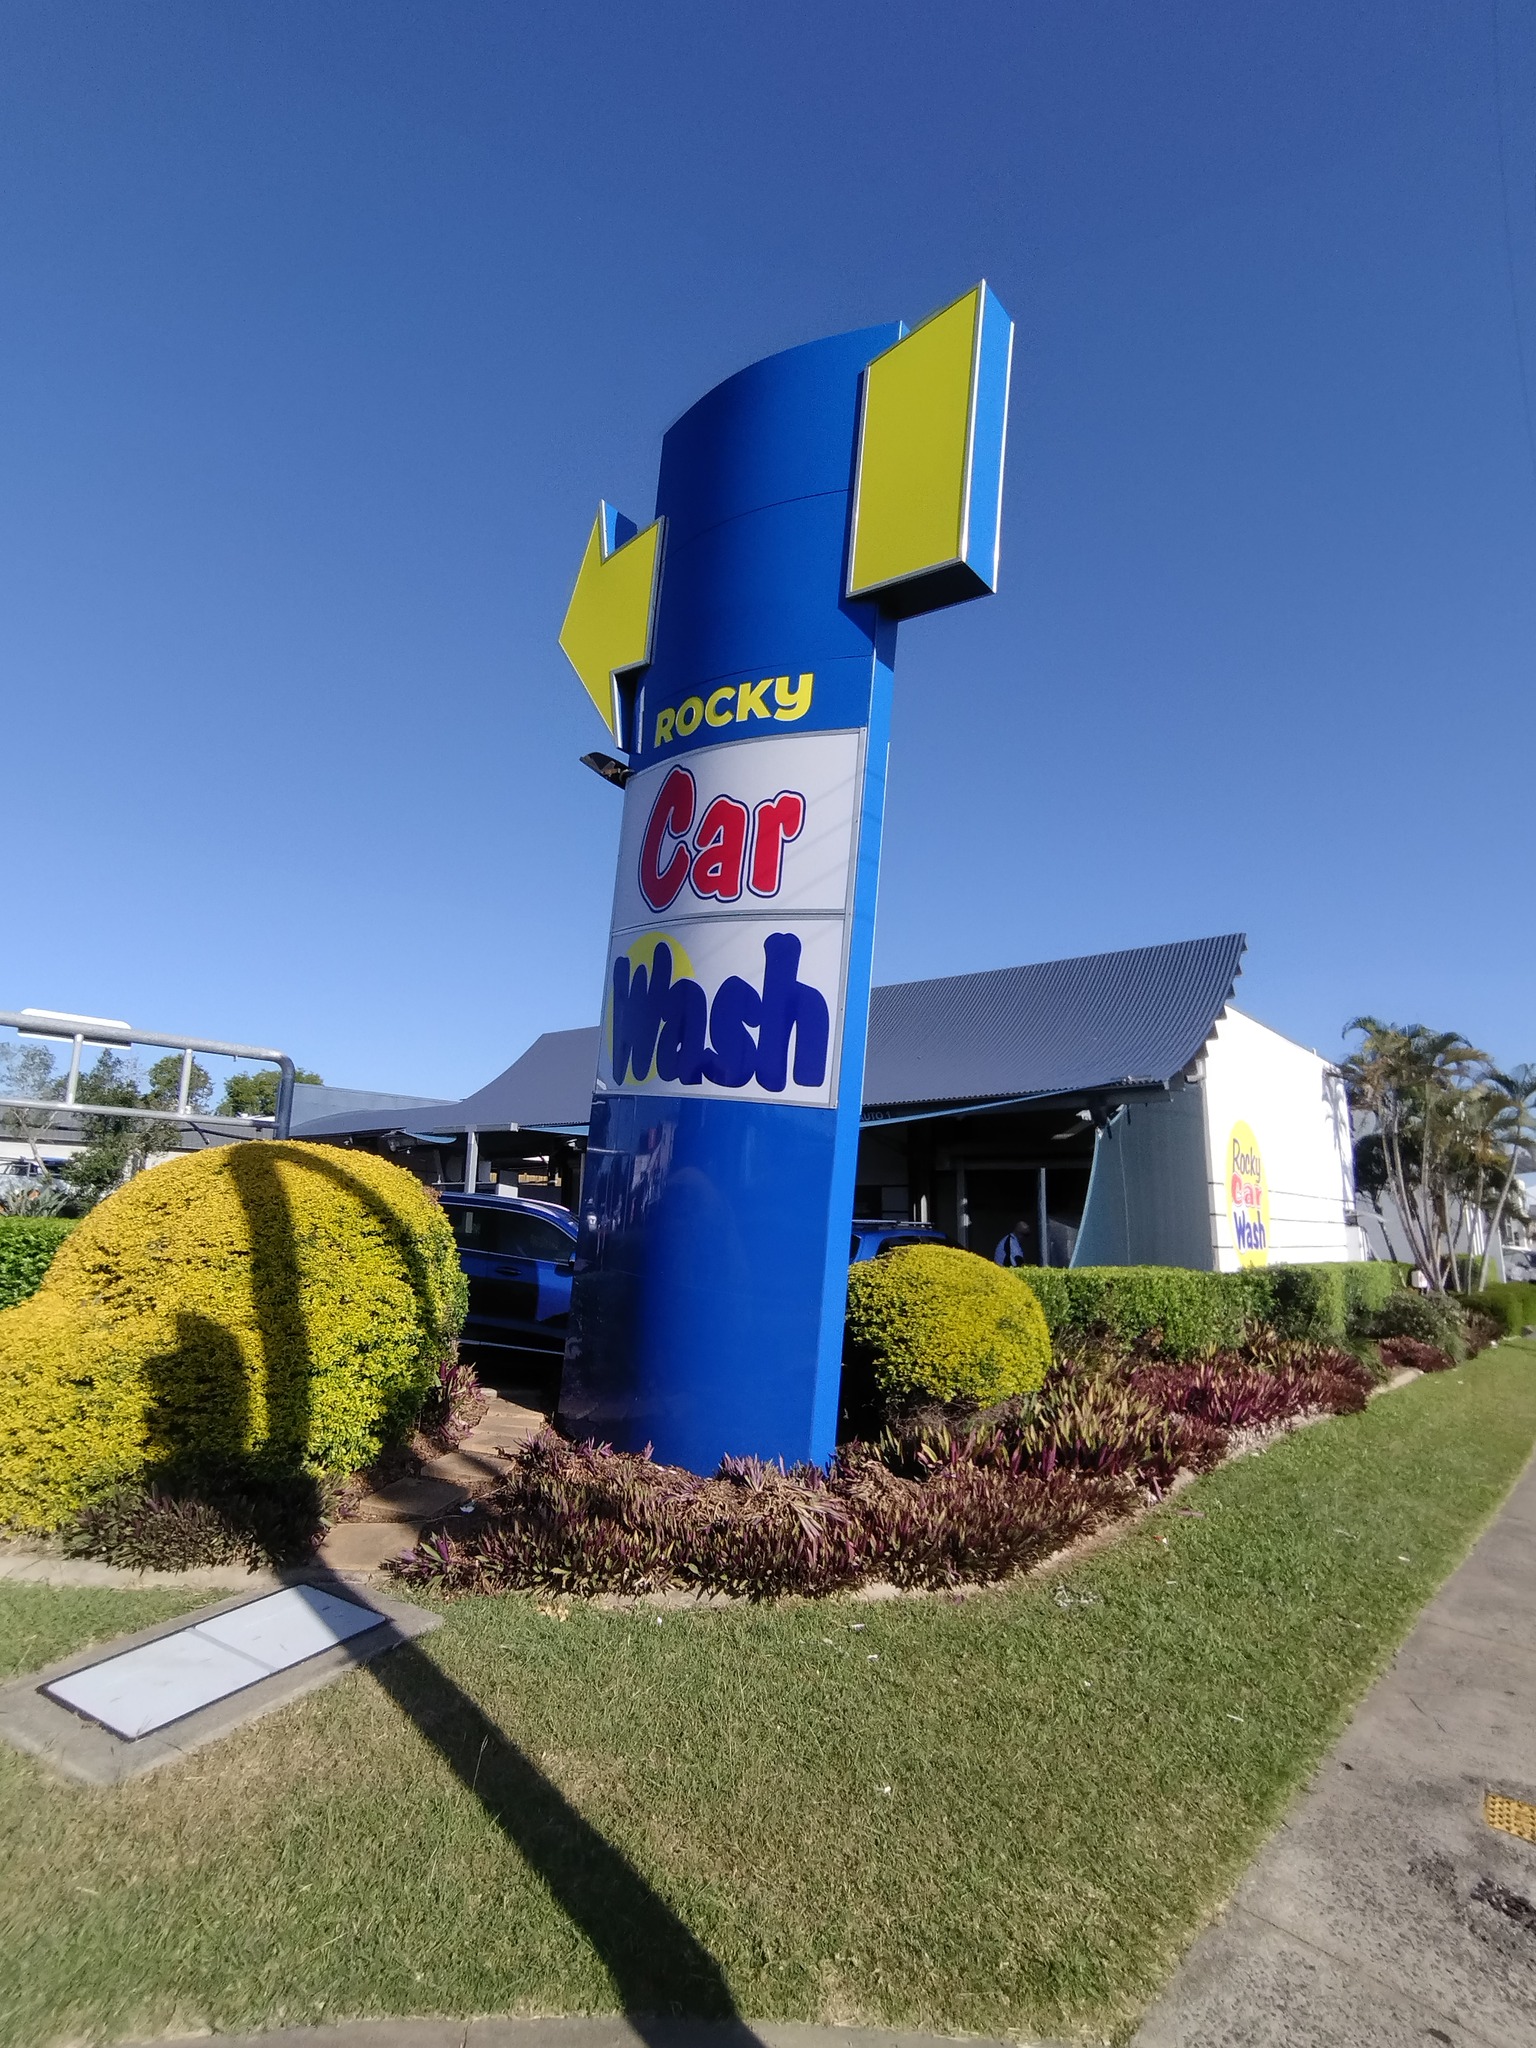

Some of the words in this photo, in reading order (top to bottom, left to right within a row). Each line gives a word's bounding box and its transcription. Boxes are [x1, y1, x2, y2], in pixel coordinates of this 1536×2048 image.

[653, 672, 815, 748] ROCKY
[638, 764, 806, 913] Car
[612, 932, 829, 1092] Wash
[1231, 1172, 1262, 1209] Car
[1232, 1138, 1261, 1183] Rocky
[1233, 1210, 1266, 1250] Wash
